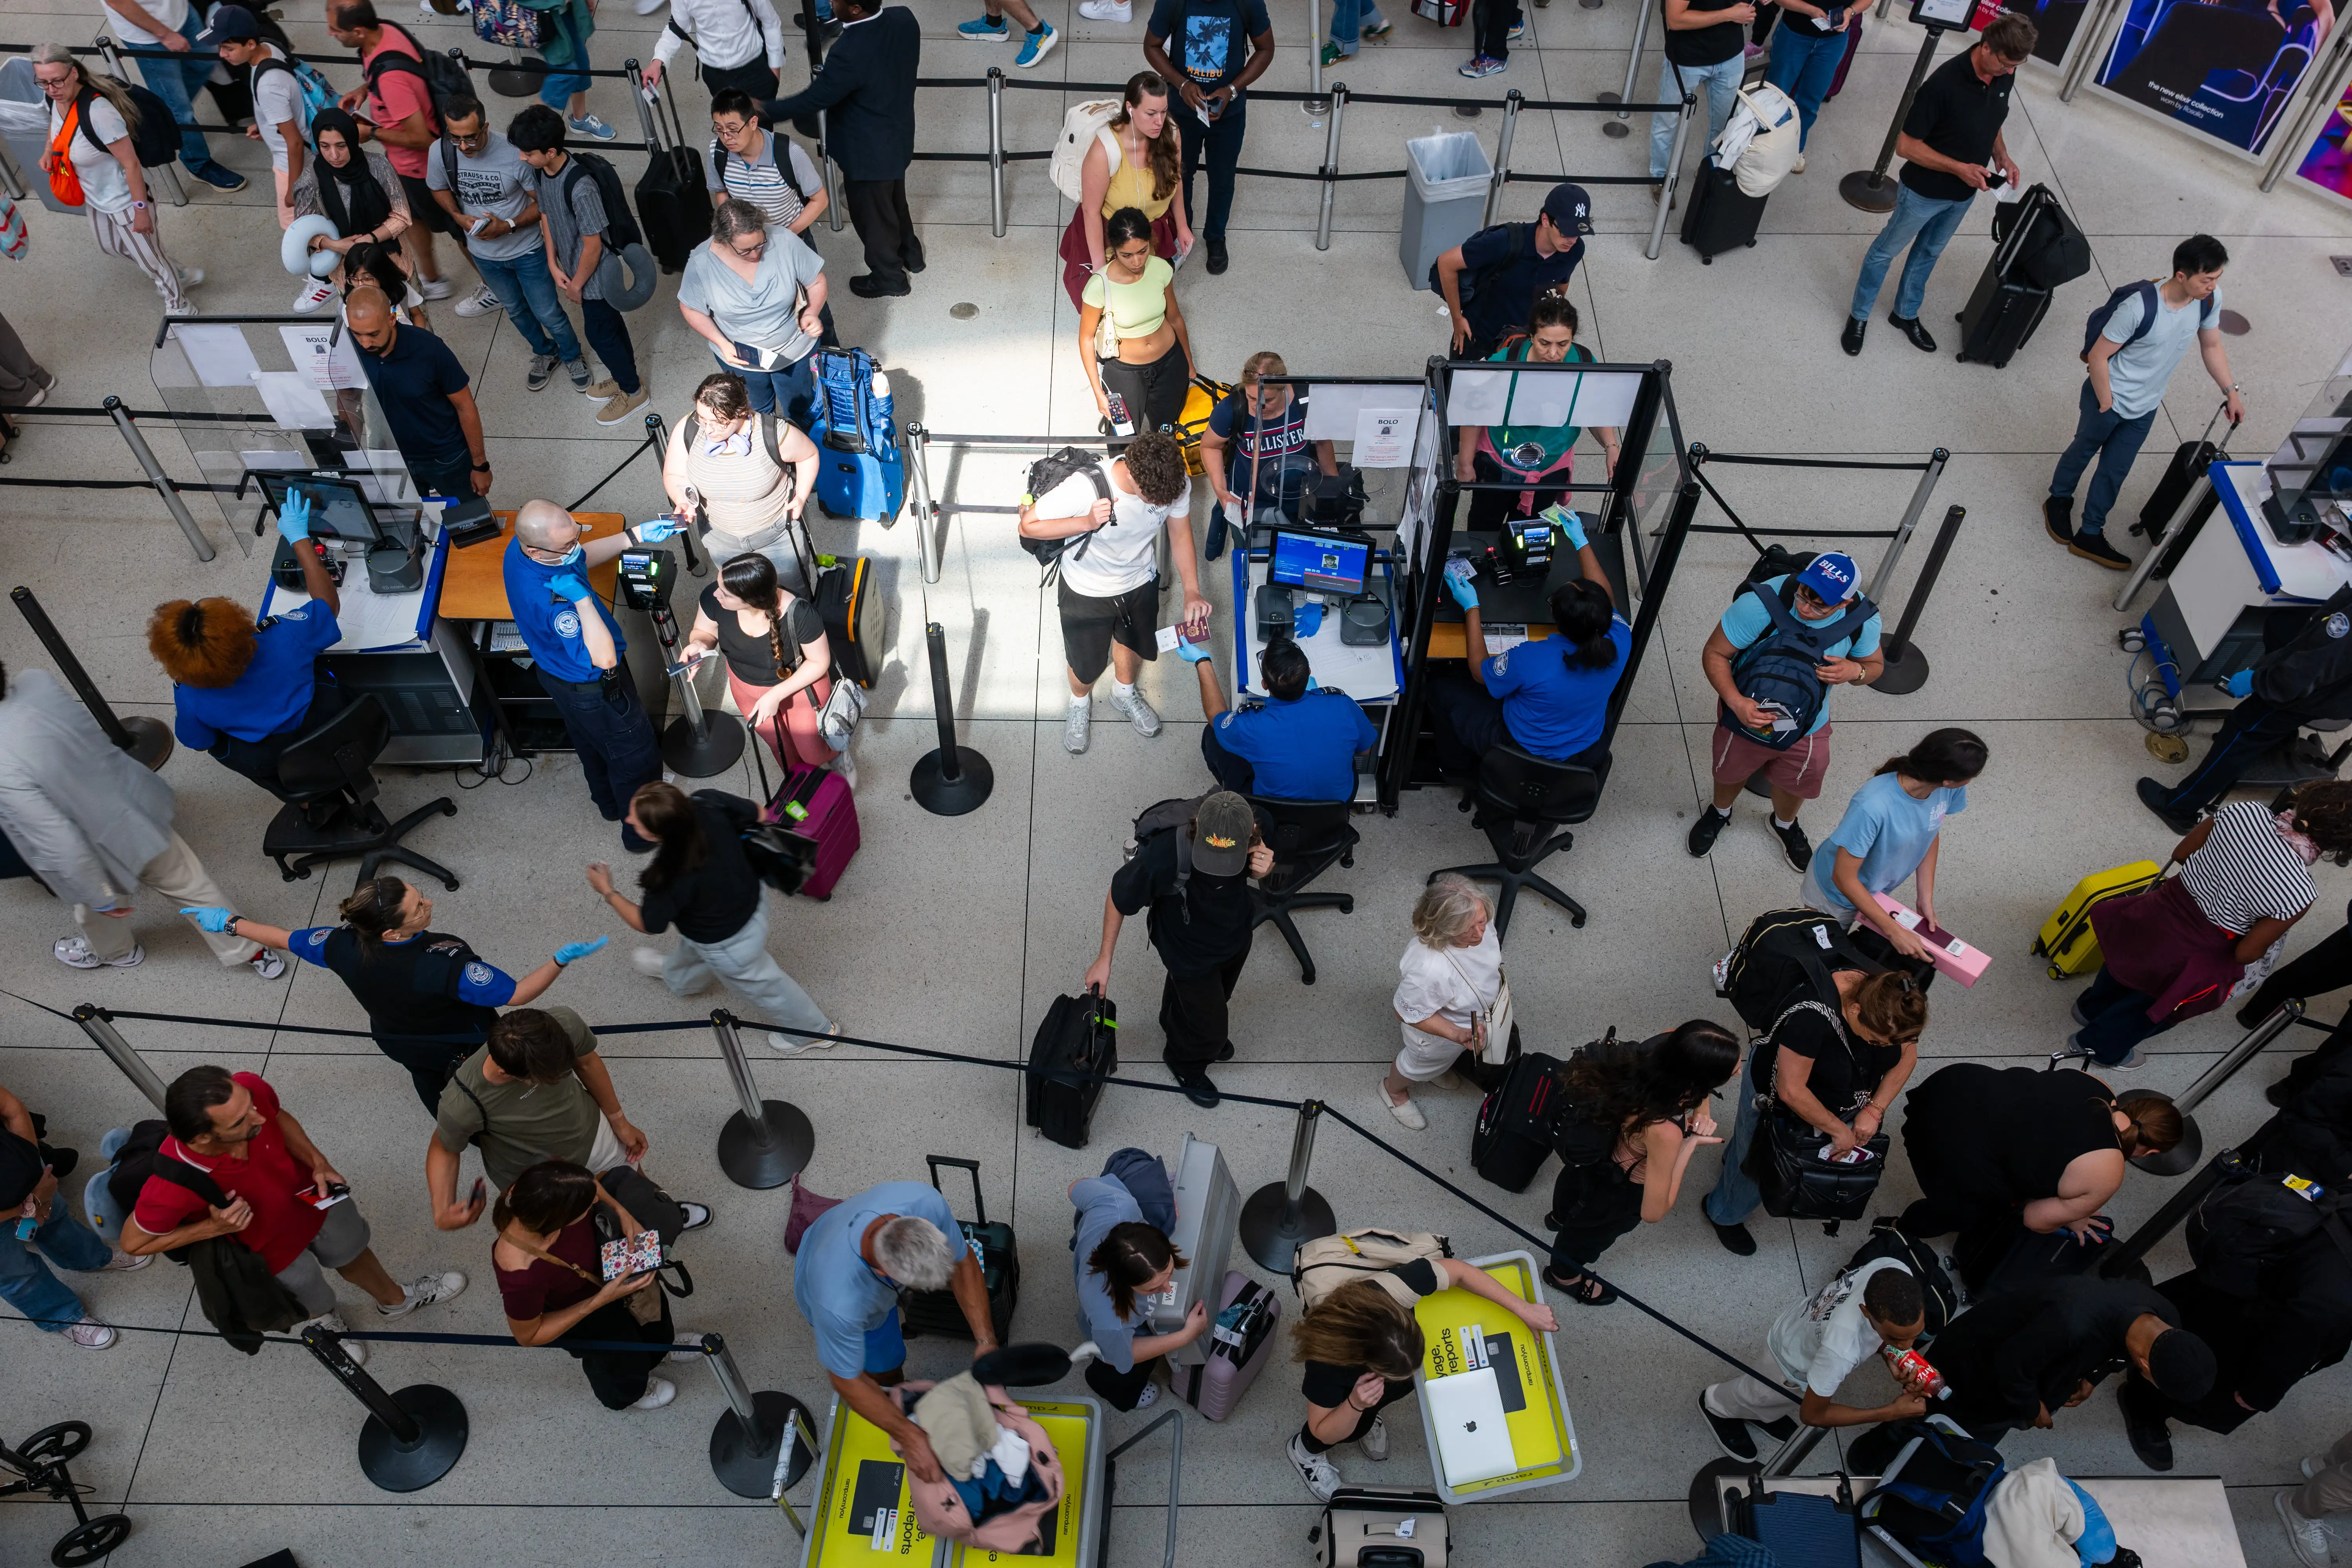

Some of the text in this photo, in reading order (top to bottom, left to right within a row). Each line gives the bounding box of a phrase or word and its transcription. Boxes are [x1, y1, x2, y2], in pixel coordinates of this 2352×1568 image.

[1187, 65, 1223, 78] MALIBU
[2148, 80, 2224, 119] the new elixir collection
[2160, 96, 2176, 106] worn
[2175, 101, 2183, 111] by
[457, 172, 483, 180] STRAUSS
[1818, 559, 1849, 583] BILLS
[261, 618, 269, 627] TSA
[2312, 1186, 2321, 1194] LOT
[1822, 1293, 1849, 1321] BEAR
[1441, 1328, 1459, 1373] reports
[1521, 1344, 1533, 1386] ramp.com/you
[1497, 1472, 1533, 1483] ramp
[821, 1481, 831, 1518] ramp
[839, 1478, 851, 1519] ramp.com/you
[901, 1510, 915, 1555] reports
